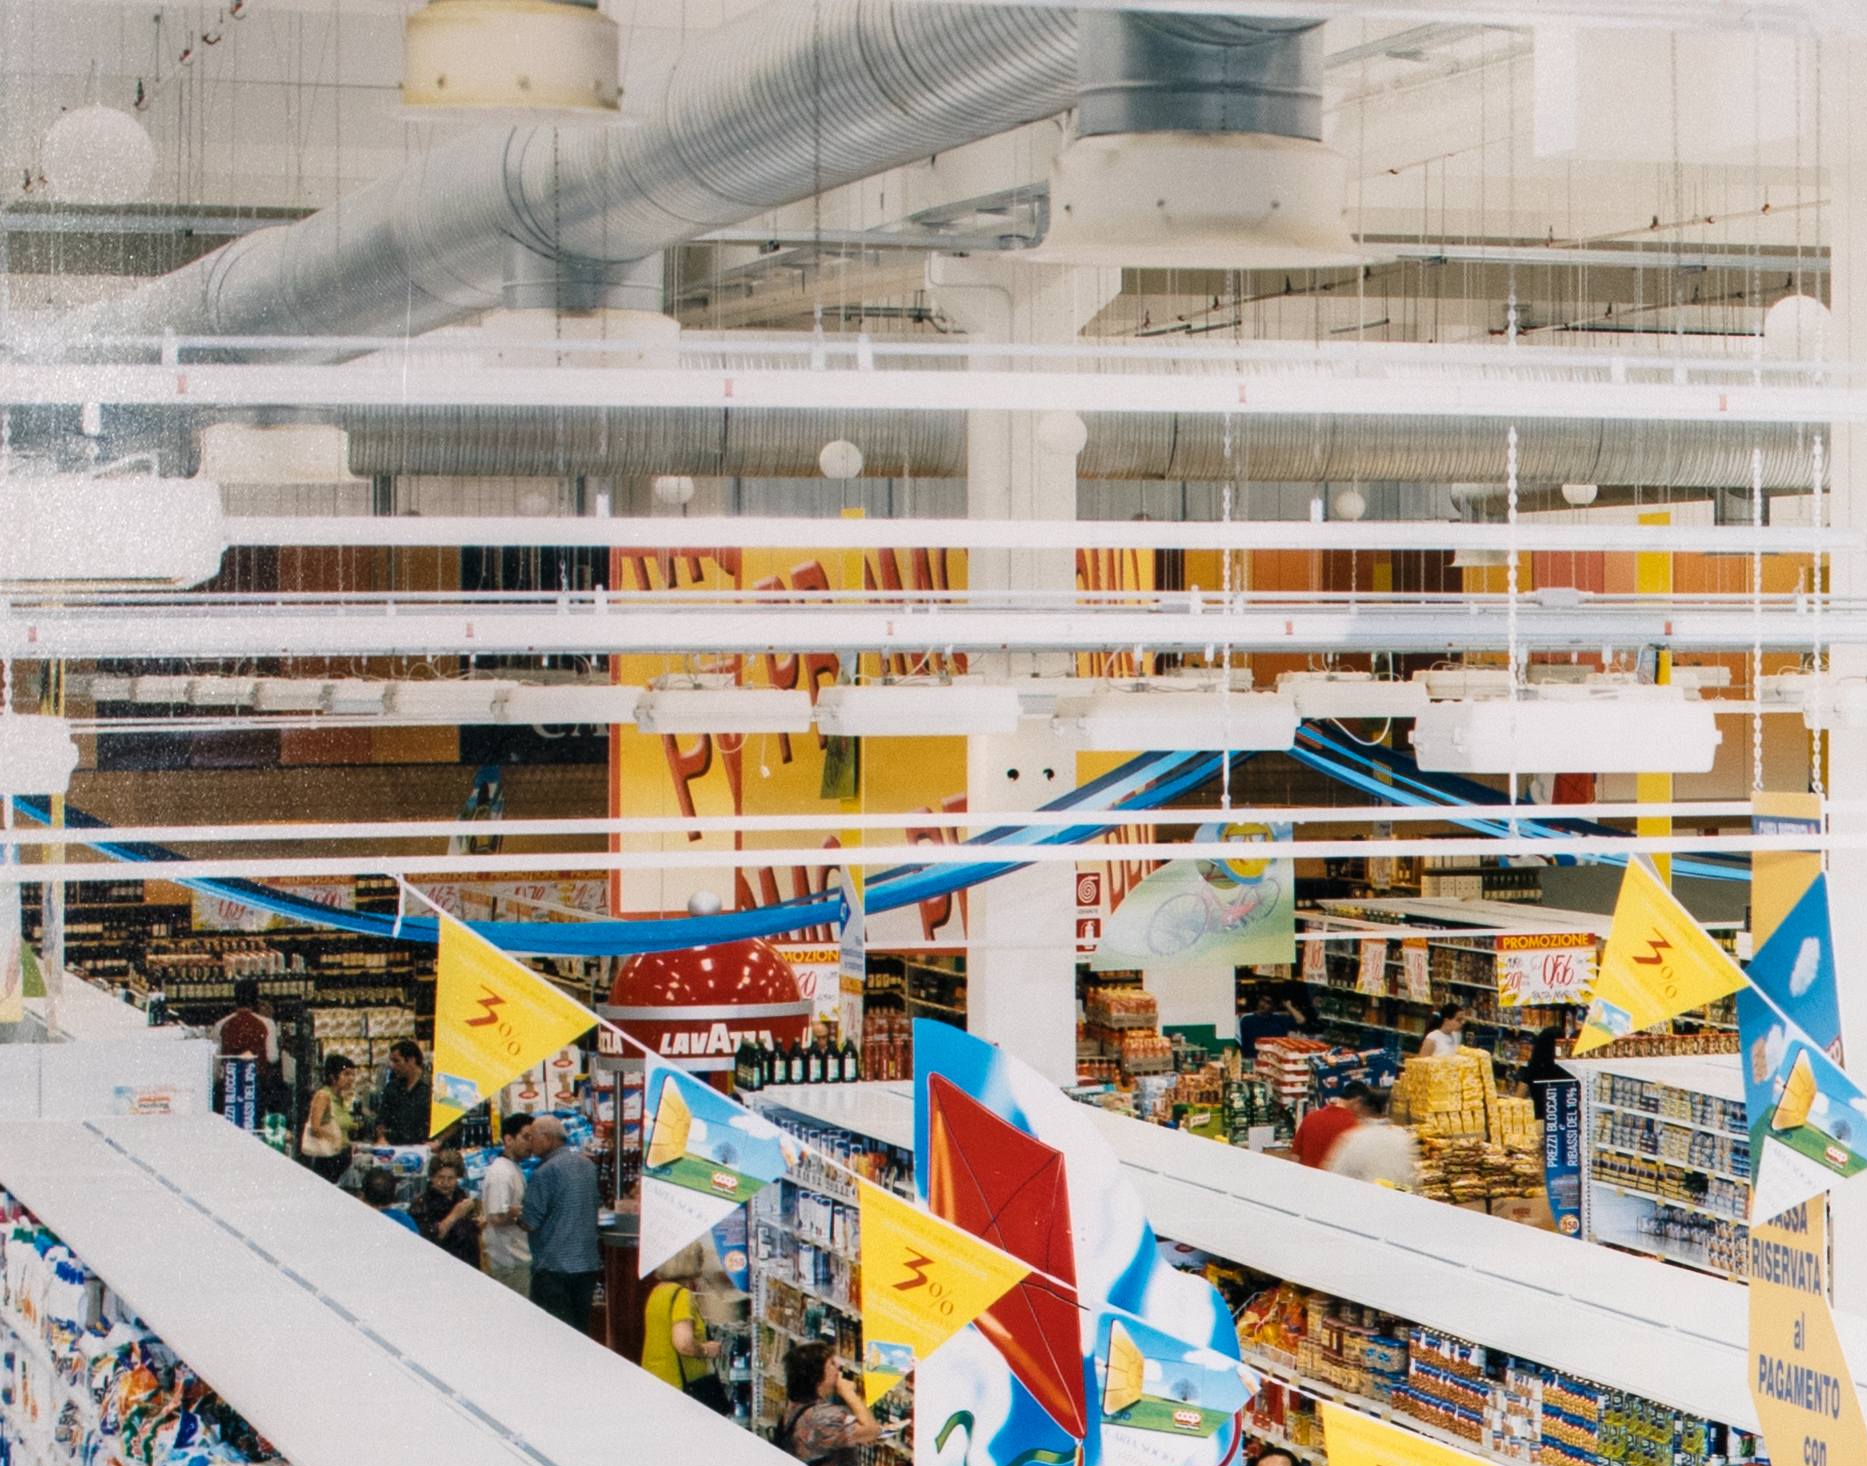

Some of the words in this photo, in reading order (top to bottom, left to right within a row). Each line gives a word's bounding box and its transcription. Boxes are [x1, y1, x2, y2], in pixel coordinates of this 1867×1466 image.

[1502, 934, 1590, 949] PROMOZIONE
[1752, 1238, 1822, 1296] RISERVATA
[1794, 1311, 1805, 1351] al
[1758, 1354, 1840, 1420] PAGAMENTO
